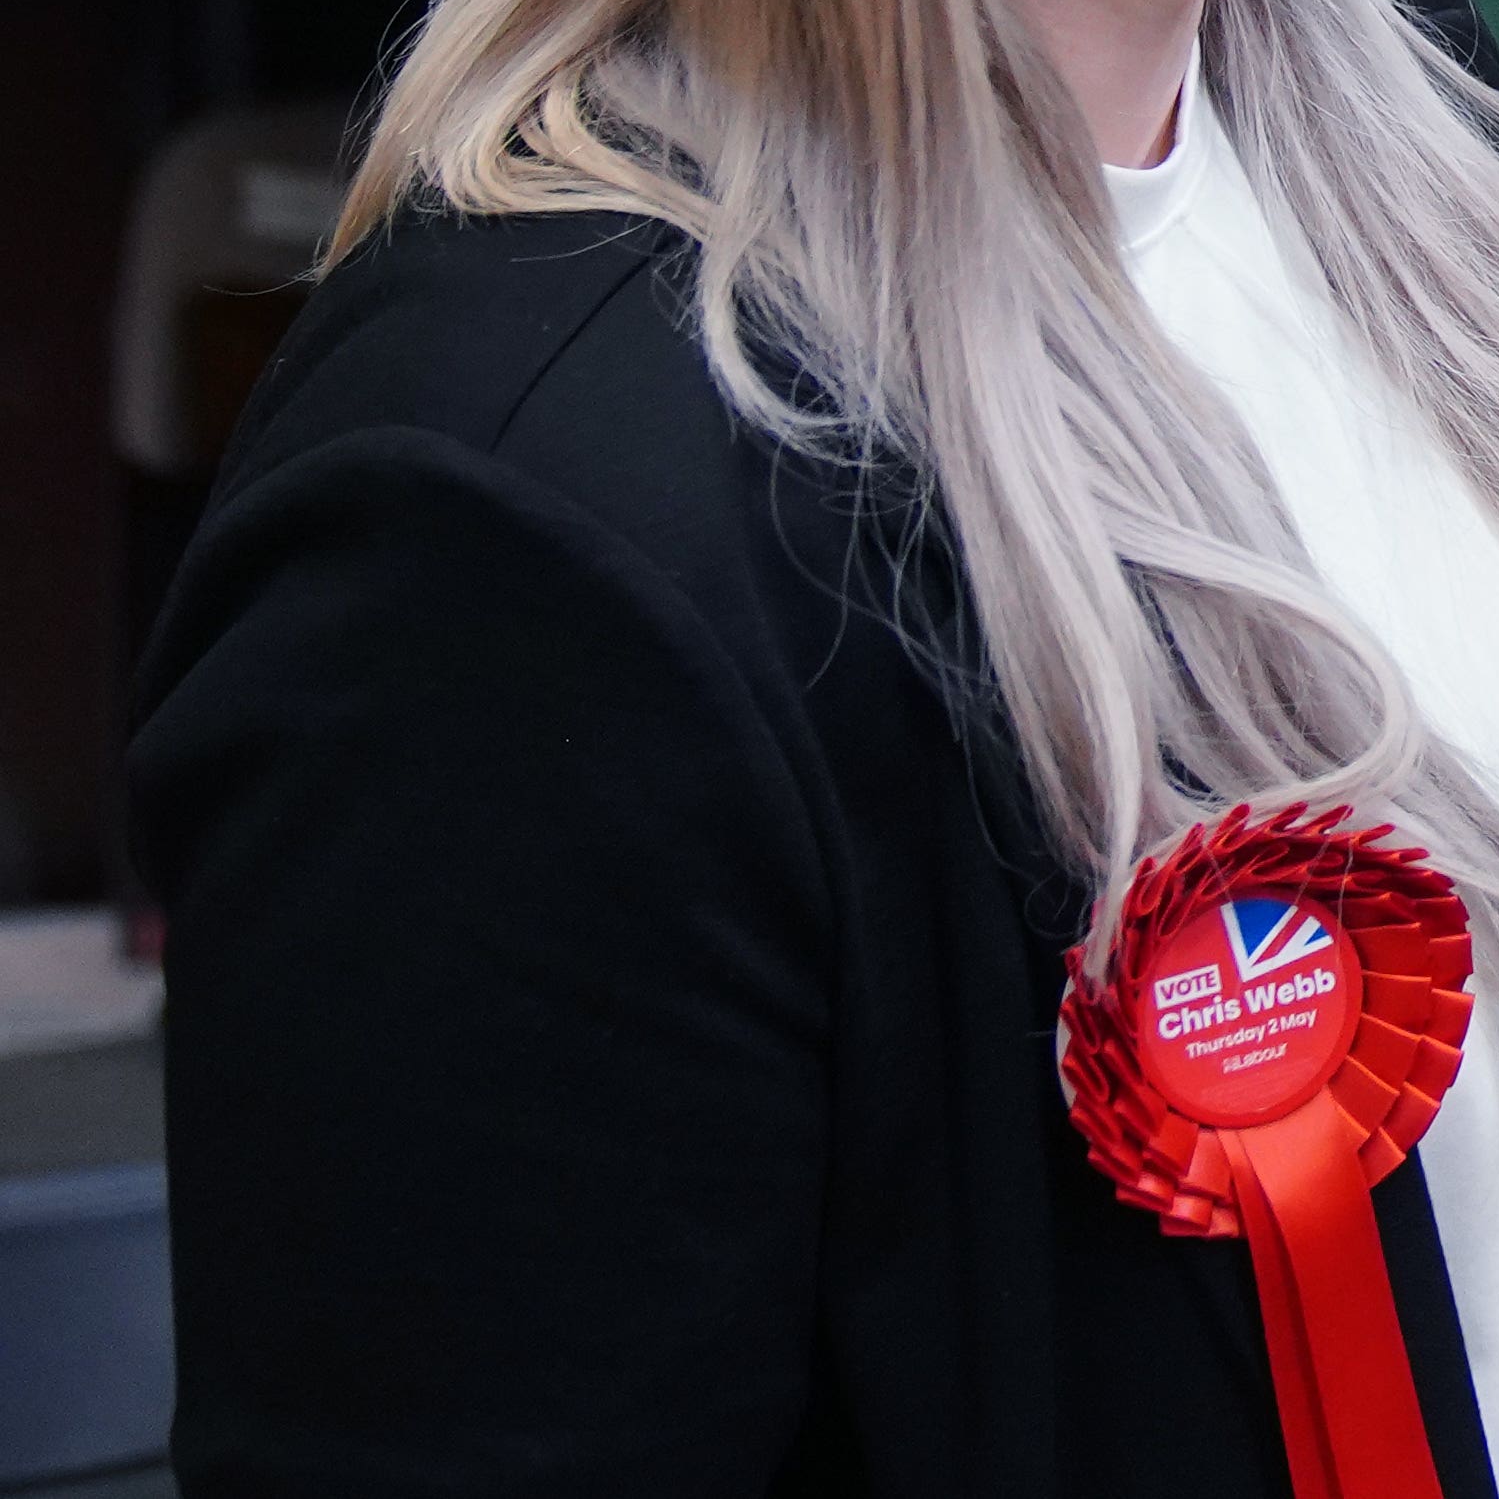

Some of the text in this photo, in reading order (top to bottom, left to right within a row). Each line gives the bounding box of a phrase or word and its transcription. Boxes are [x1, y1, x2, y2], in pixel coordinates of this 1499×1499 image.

[1158, 968, 1336, 1039] Chris Webb
[1160, 970, 1217, 1001] VOTE
[1185, 1009, 1317, 1059] Thursday 2 May
